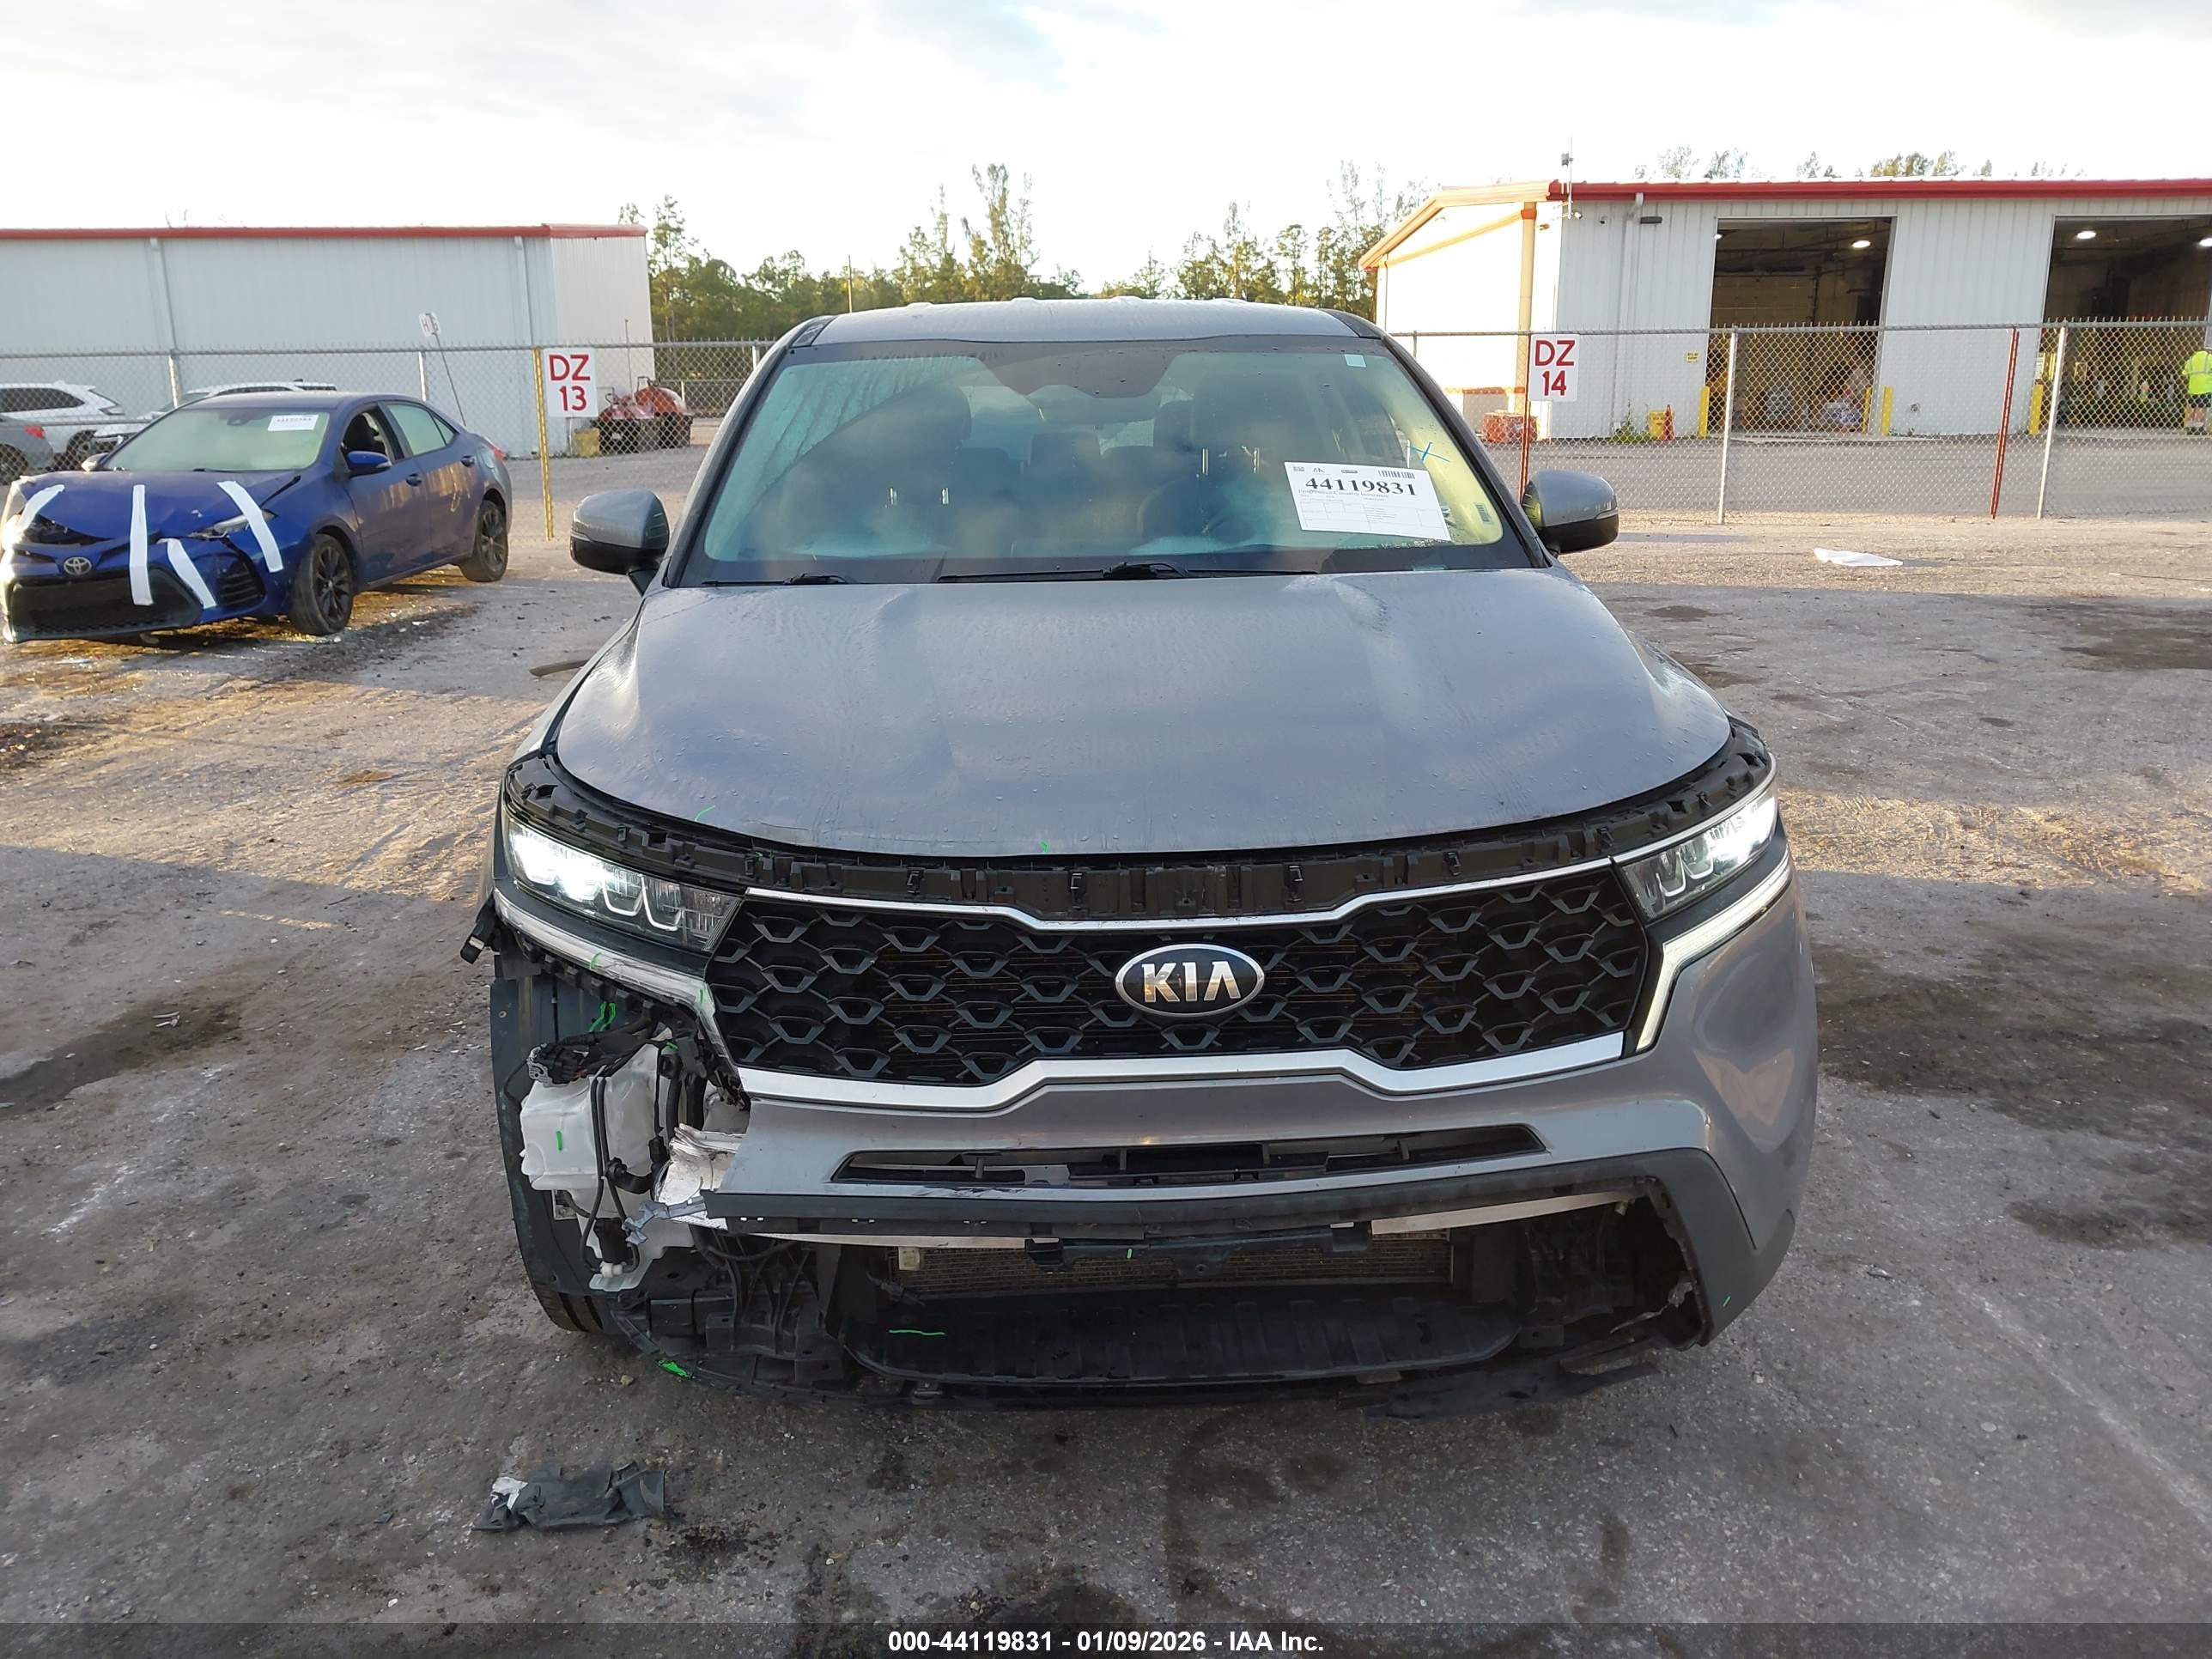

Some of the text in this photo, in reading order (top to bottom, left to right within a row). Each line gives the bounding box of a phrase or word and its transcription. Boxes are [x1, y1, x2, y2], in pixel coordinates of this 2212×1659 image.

[1534, 339, 1576, 367] DZ
[548, 354, 591, 381] DZ
[1542, 370, 1567, 397] 14
[558, 385, 587, 411] 13
[1305, 477, 1418, 496] 44119831
[1141, 961, 1242, 1003] KIA
